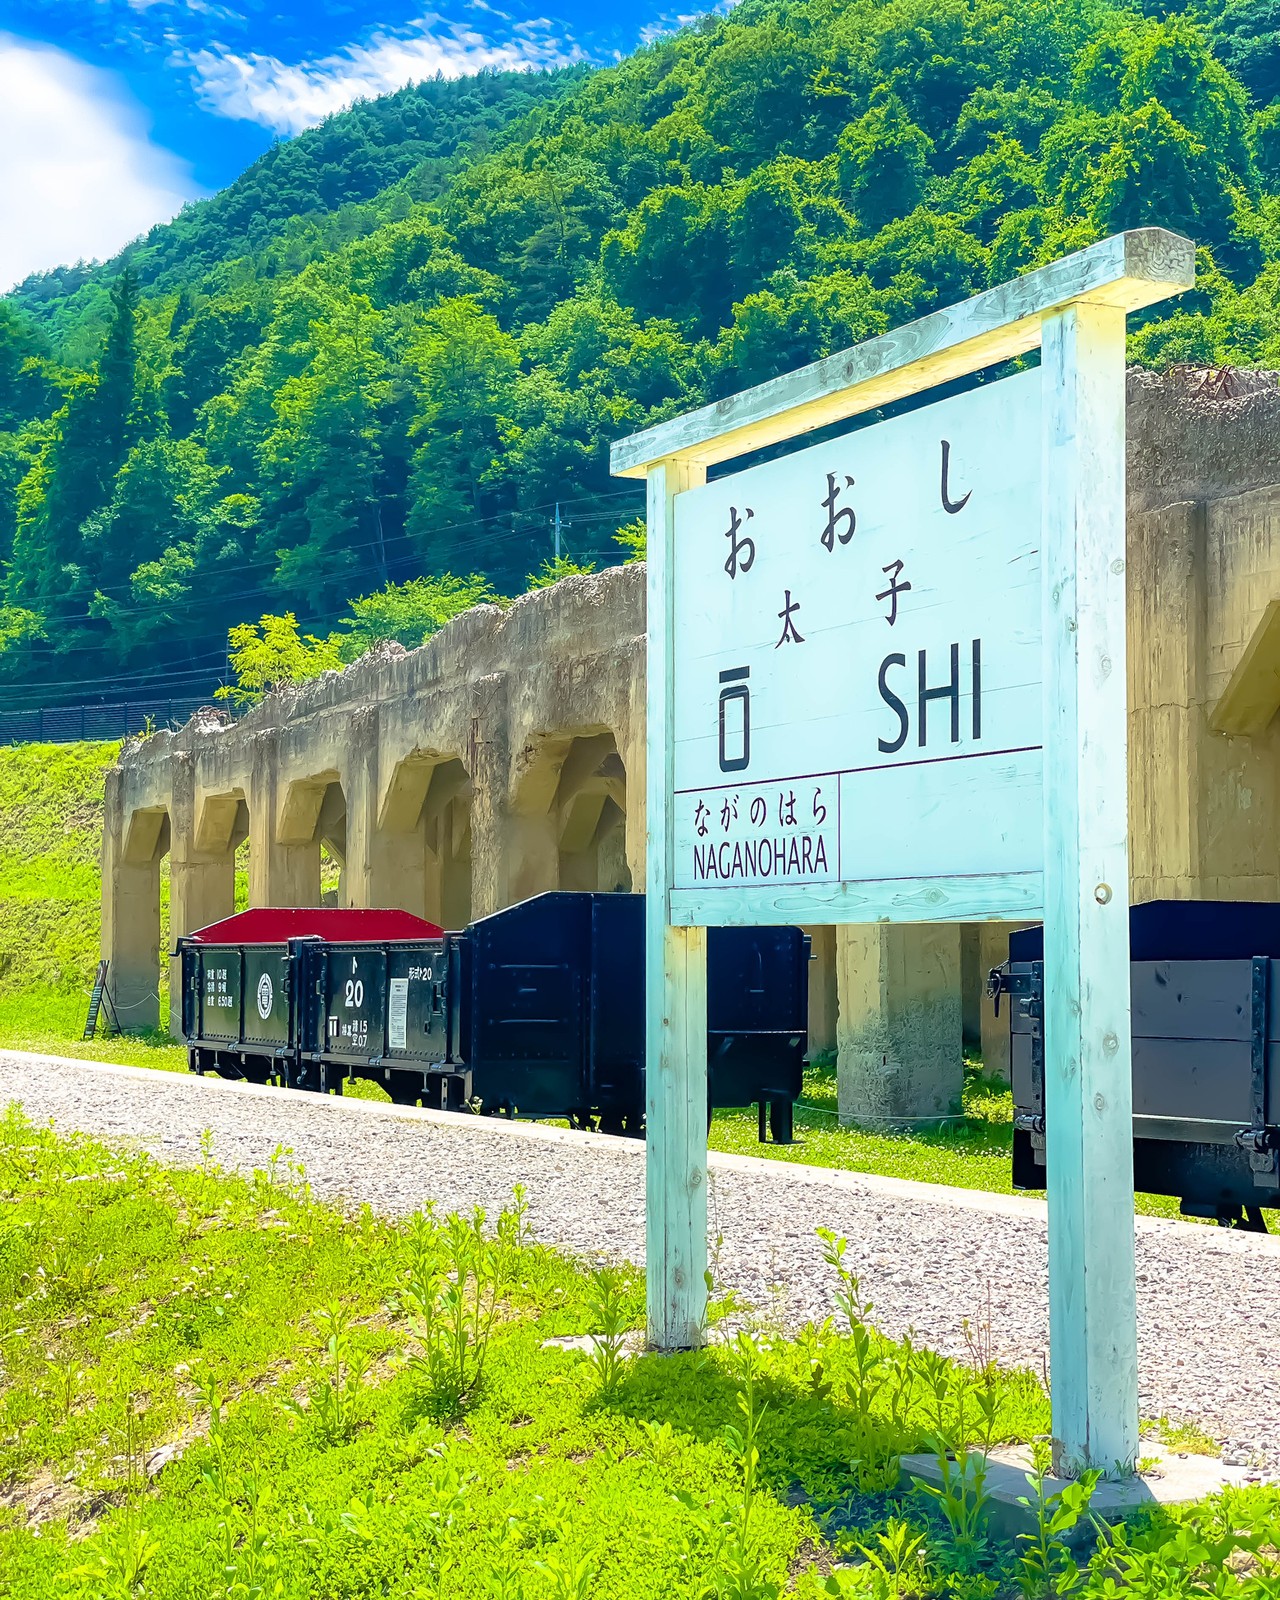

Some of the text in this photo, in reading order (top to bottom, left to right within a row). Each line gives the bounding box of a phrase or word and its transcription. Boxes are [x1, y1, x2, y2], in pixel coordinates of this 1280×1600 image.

[774, 559, 912, 650] 太子
[877, 638, 981, 753] SHI
[693, 786, 828, 838] ながのはら
[693, 834, 829, 881] NAGANOHARA
[344, 979, 364, 1008] 20
